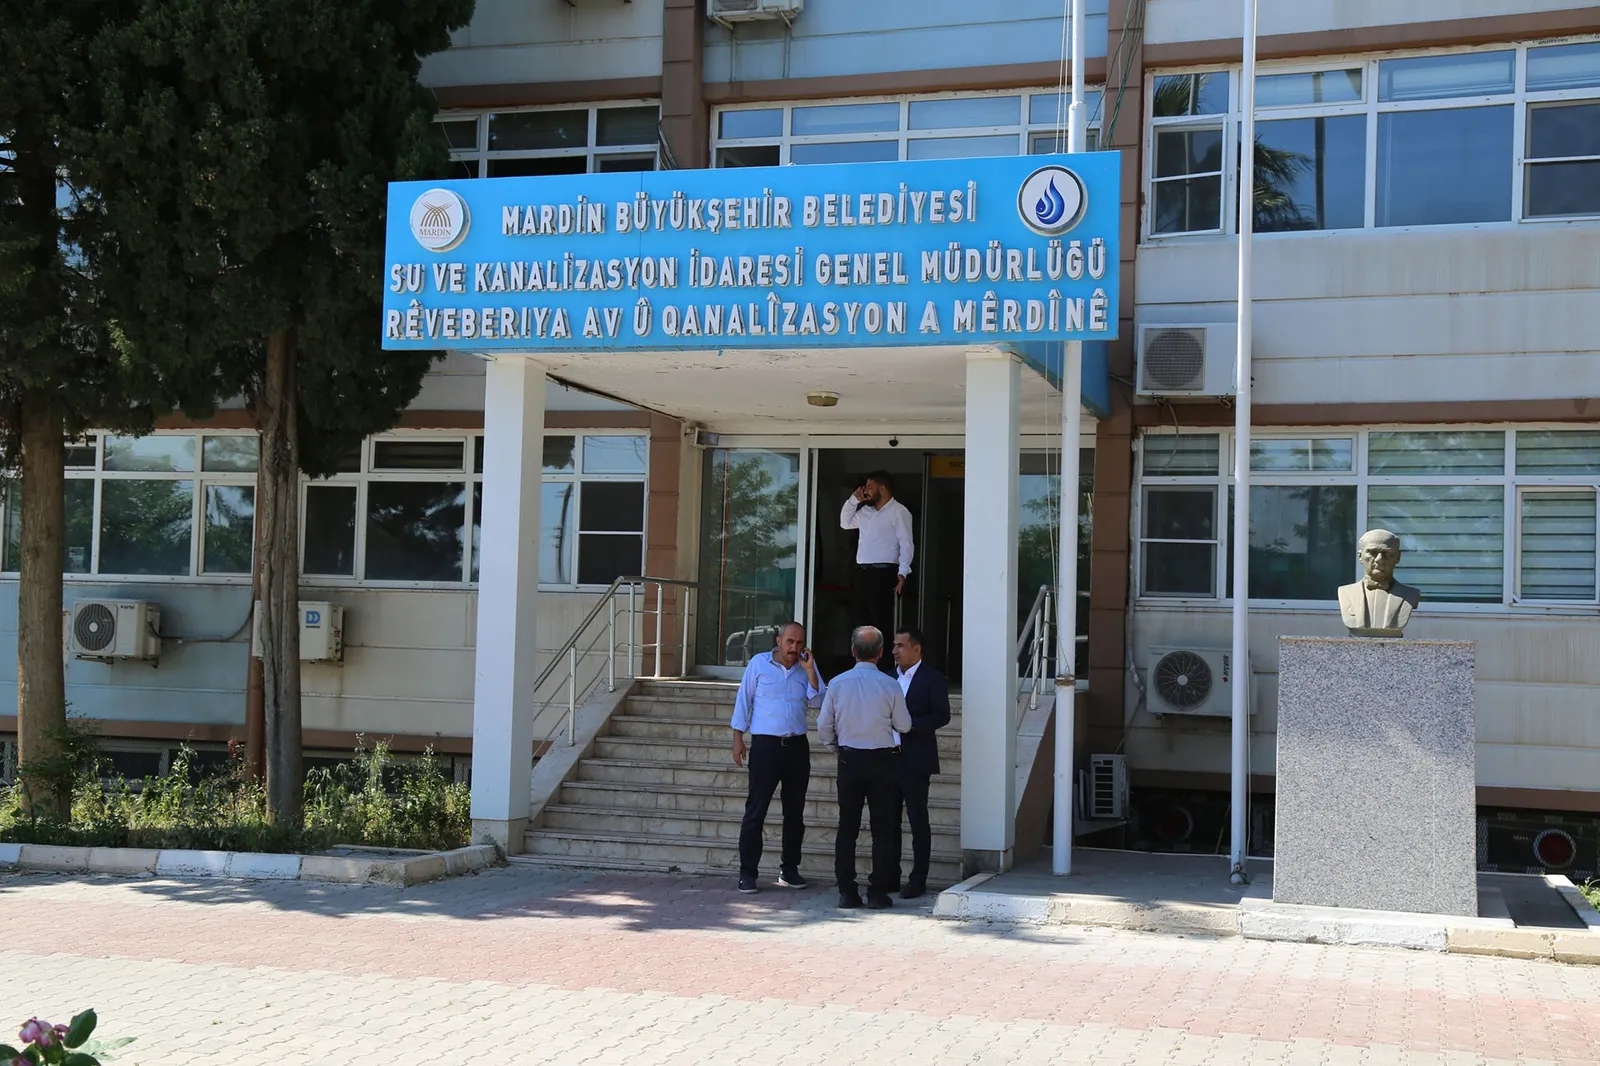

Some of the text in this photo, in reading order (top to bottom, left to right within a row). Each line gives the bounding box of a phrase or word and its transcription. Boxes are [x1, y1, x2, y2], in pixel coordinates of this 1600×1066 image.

[501, 180, 977, 235] MARDİN BÜYÜKŞEHİR BELEDİYESİ
[390, 238, 1106, 292] SU VE KANALİZASYON İDARESİ GENEL MÜDÜRLÜĞÜ
[385, 288, 1108, 339] RÊVEBERIYA AV Û QANALÎZASYON A MÊRDÎNÊ
